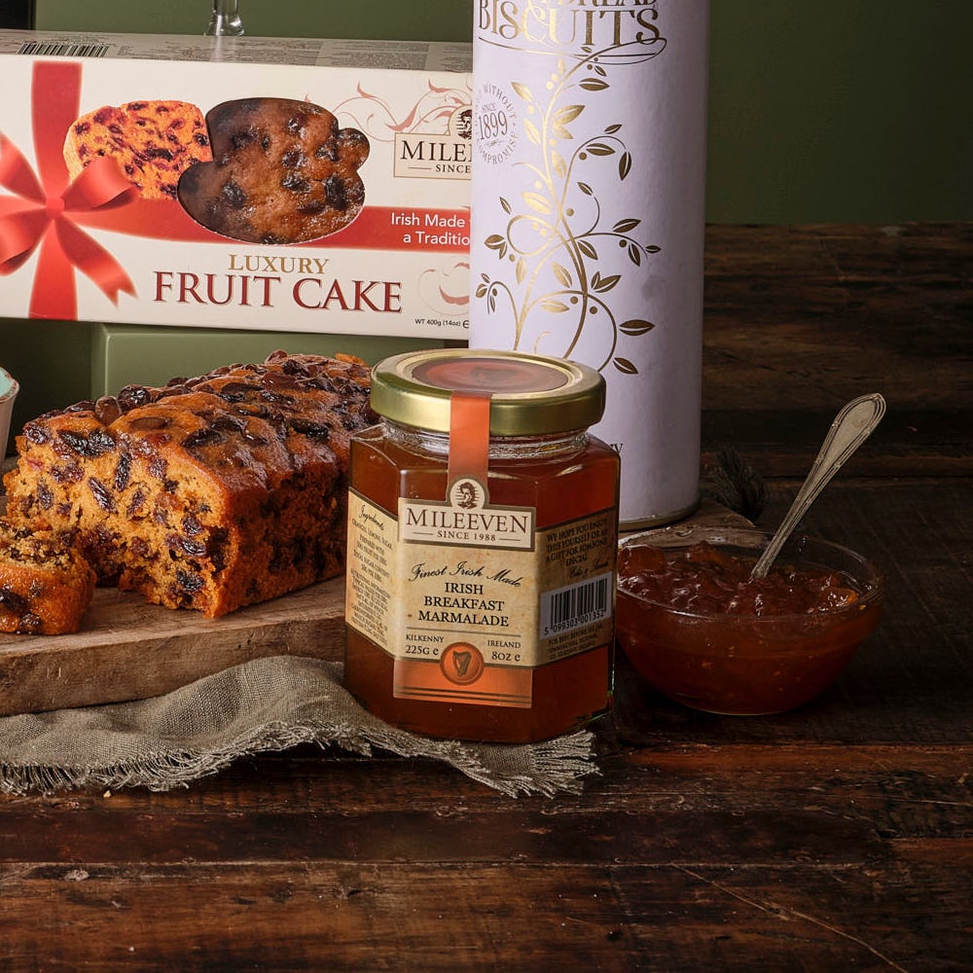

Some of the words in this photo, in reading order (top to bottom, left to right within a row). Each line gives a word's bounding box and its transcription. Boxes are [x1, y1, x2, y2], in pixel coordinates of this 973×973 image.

[478, 110, 508, 140] 1899
[400, 140, 472, 163] MILE
[435, 164, 471, 174] SINCE
[391, 212, 420, 226] Irish
[425, 213, 465, 228] Made
[403, 234, 412, 243] a
[228, 254, 329, 274] LUXURY
[153, 271, 281, 307] FRUIT
[292, 277, 403, 313] CAKE
[427, 319, 442, 327] 400g
[406, 508, 528, 534] MILEEVEN
[437, 530, 469, 540] SINCE
[473, 532, 496, 542] 1988
[408, 562, 448, 582] Finest
[449, 561, 485, 577] Irish
[486, 569, 524, 587] Made
[445, 582, 484, 595] IRISH
[424, 595, 505, 612] BREAKFAST
[418, 610, 509, 627] MARMALADE
[405, 634, 445, 643] KILKENNY
[487, 640, 521, 648] IRELAND
[405, 645, 430, 655] 225G
